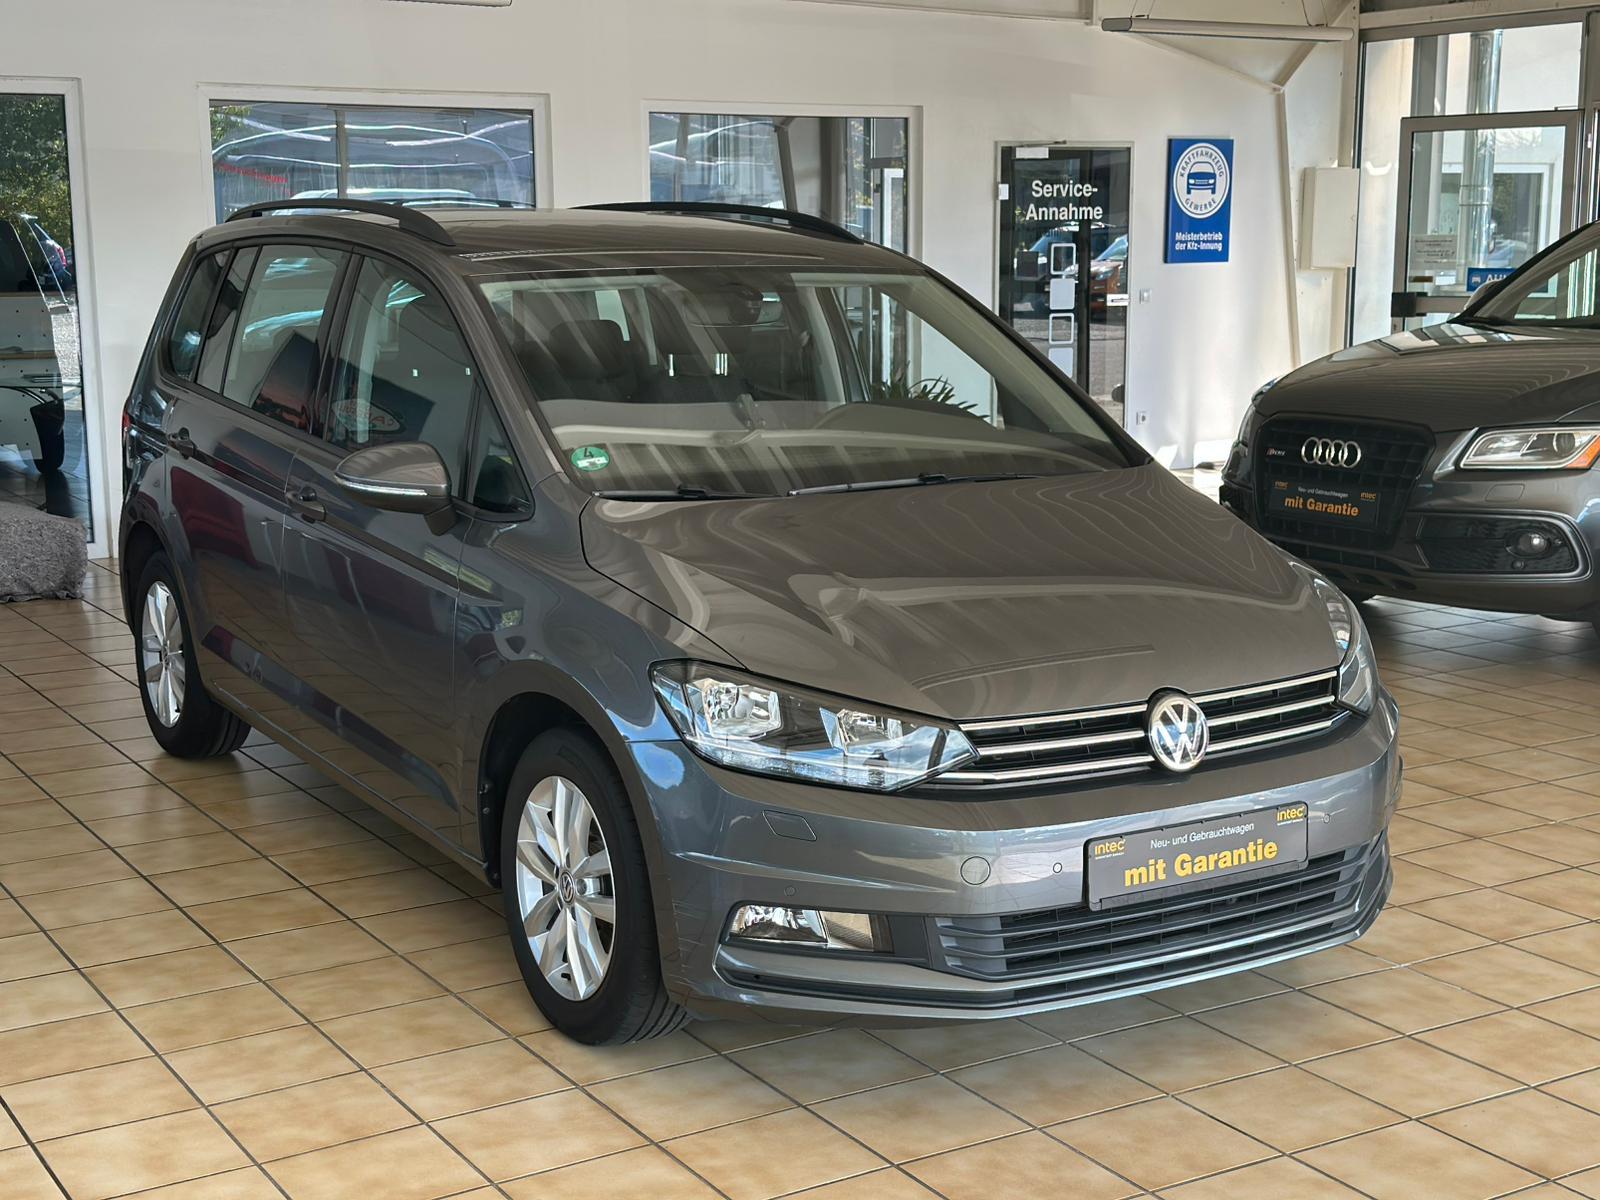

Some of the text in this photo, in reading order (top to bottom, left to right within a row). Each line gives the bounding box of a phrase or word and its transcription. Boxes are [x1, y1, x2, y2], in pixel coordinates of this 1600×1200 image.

[1179, 149, 1225, 178] KRAFTFAHRZEUG
[1031, 180, 1098, 198] Service-
[1025, 203, 1103, 221] Annahme
[1184, 197, 1217, 212] GEWERBE
[1175, 232, 1223, 241] Meisterbetrieb
[1175, 242, 1223, 252] der Kfz-Innung
[1284, 495, 1360, 517] mit Garantie
[1276, 805, 1305, 821] intec
[1150, 823, 1255, 849] Neu- und Gebrauchtwagen
[1094, 838, 1126, 855] intec
[1124, 838, 1279, 888] mit Garantie
